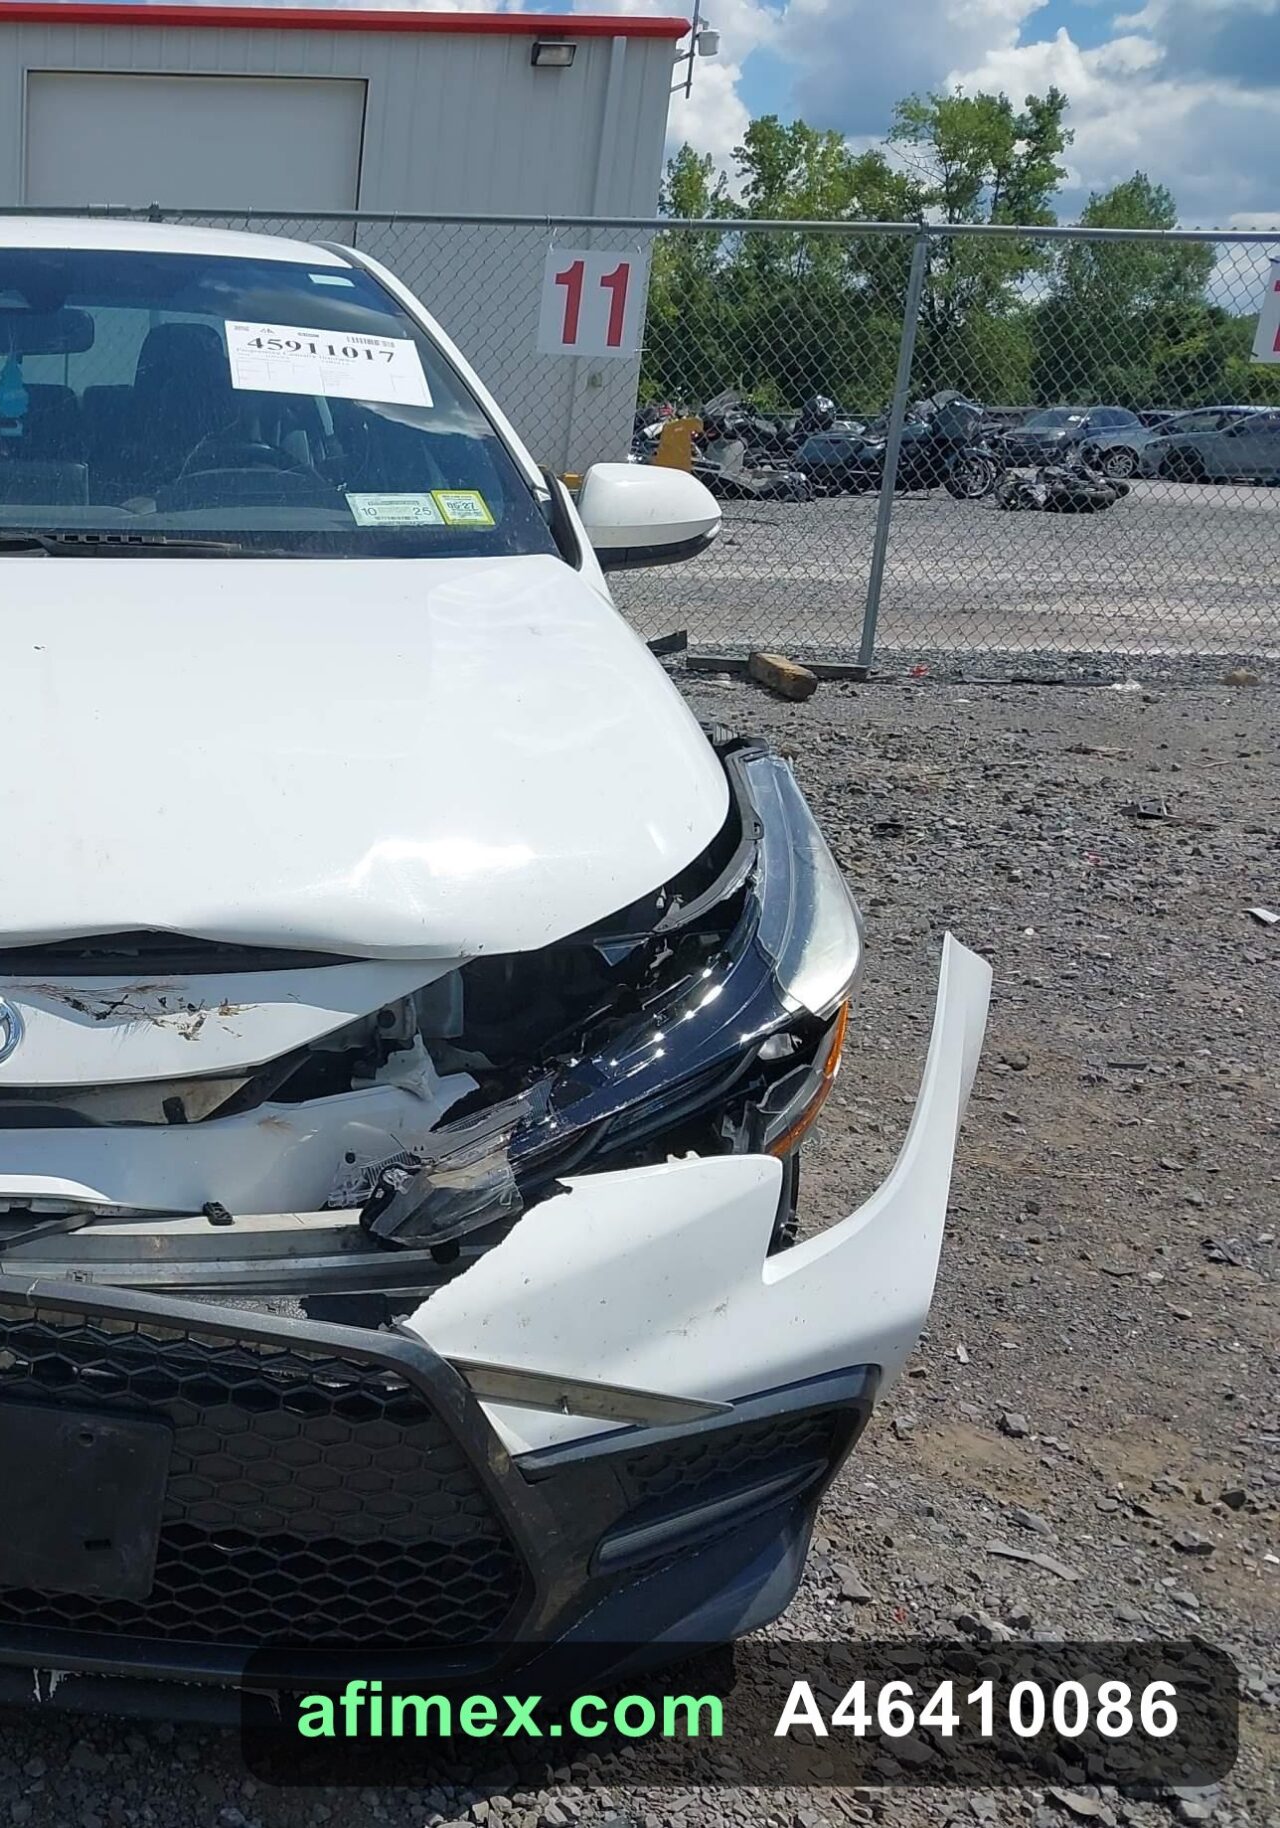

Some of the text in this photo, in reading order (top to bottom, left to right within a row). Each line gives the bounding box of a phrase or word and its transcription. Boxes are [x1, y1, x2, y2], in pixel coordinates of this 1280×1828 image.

[554, 261, 630, 347] 11
[247, 337, 394, 363] 45911017
[360, 507, 432, 516] 10 25
